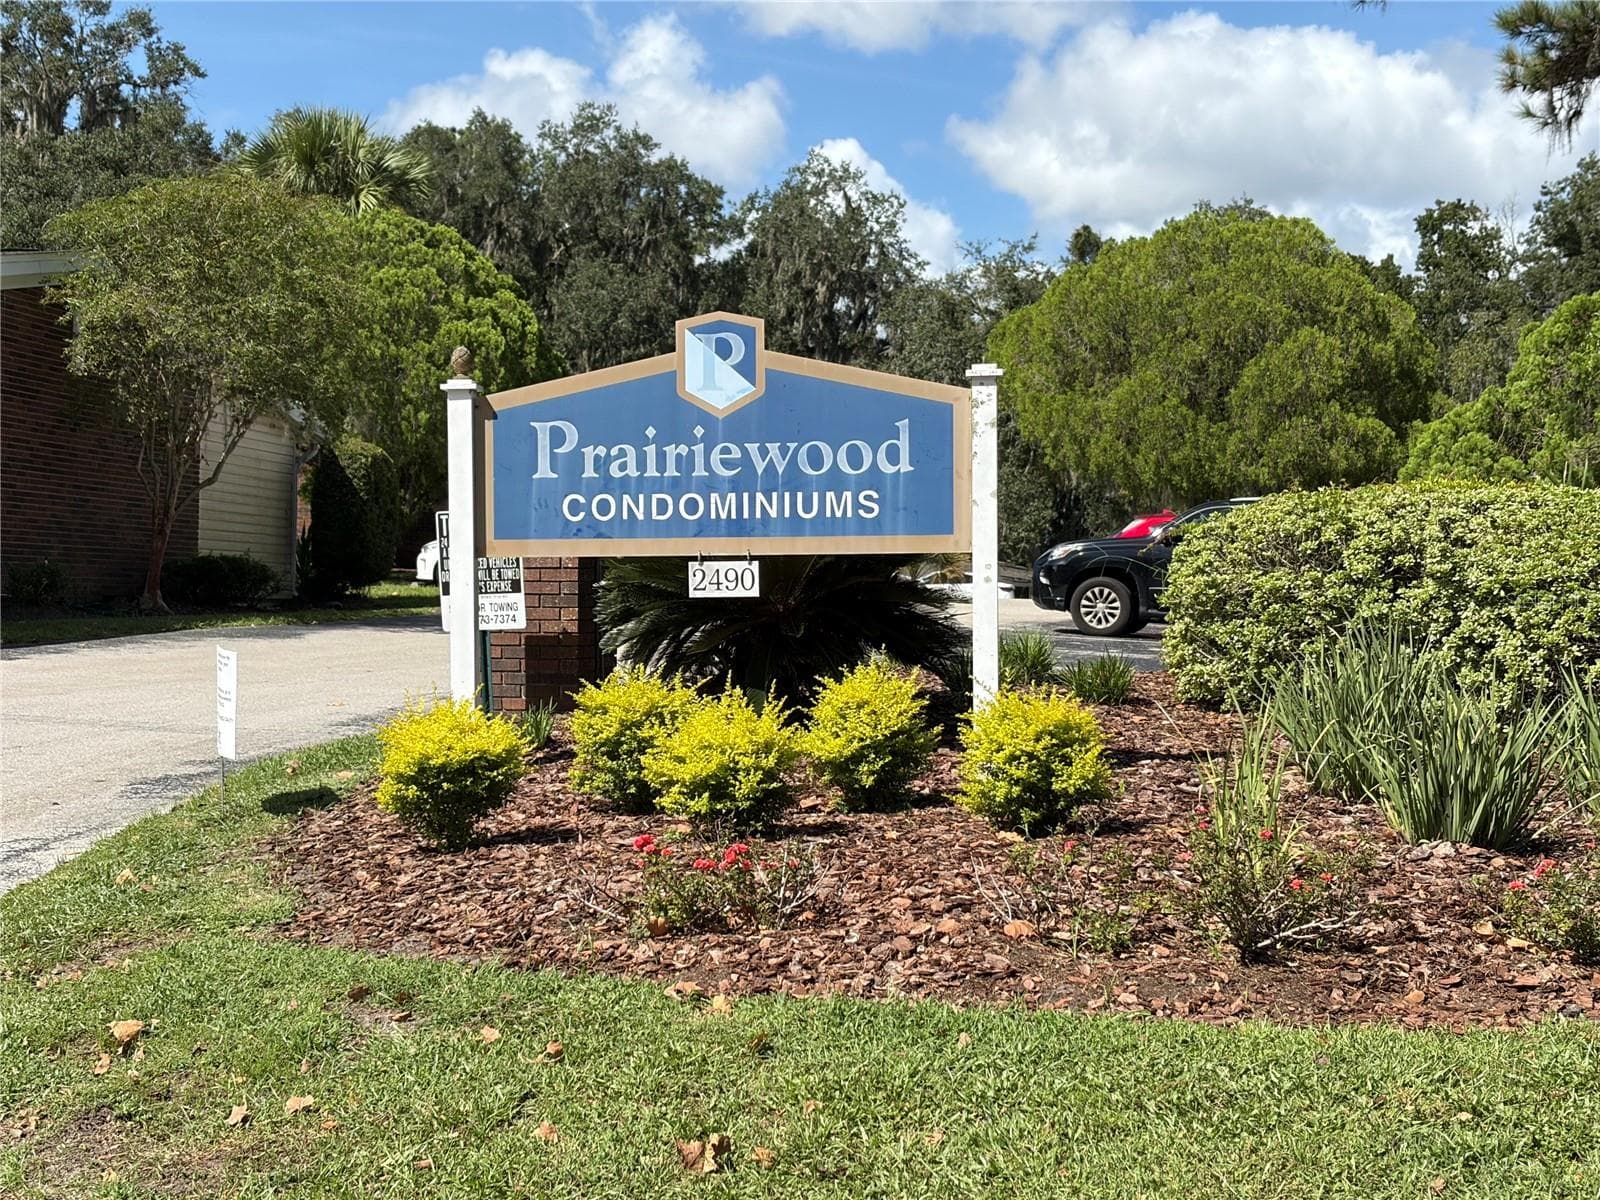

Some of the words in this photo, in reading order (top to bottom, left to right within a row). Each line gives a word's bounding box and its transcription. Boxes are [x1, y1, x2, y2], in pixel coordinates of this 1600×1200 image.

[694, 331, 745, 391] P
[530, 418, 914, 479] Prairiewood
[562, 491, 880, 522] CONDOMINIUMS
[489, 556, 517, 568] VEHICLES
[492, 569, 500, 580] BE
[501, 568, 520, 580] TOWED
[692, 567, 756, 592] 2490
[487, 580, 512, 592] EXPENSE
[489, 602, 519, 612] TOWING
